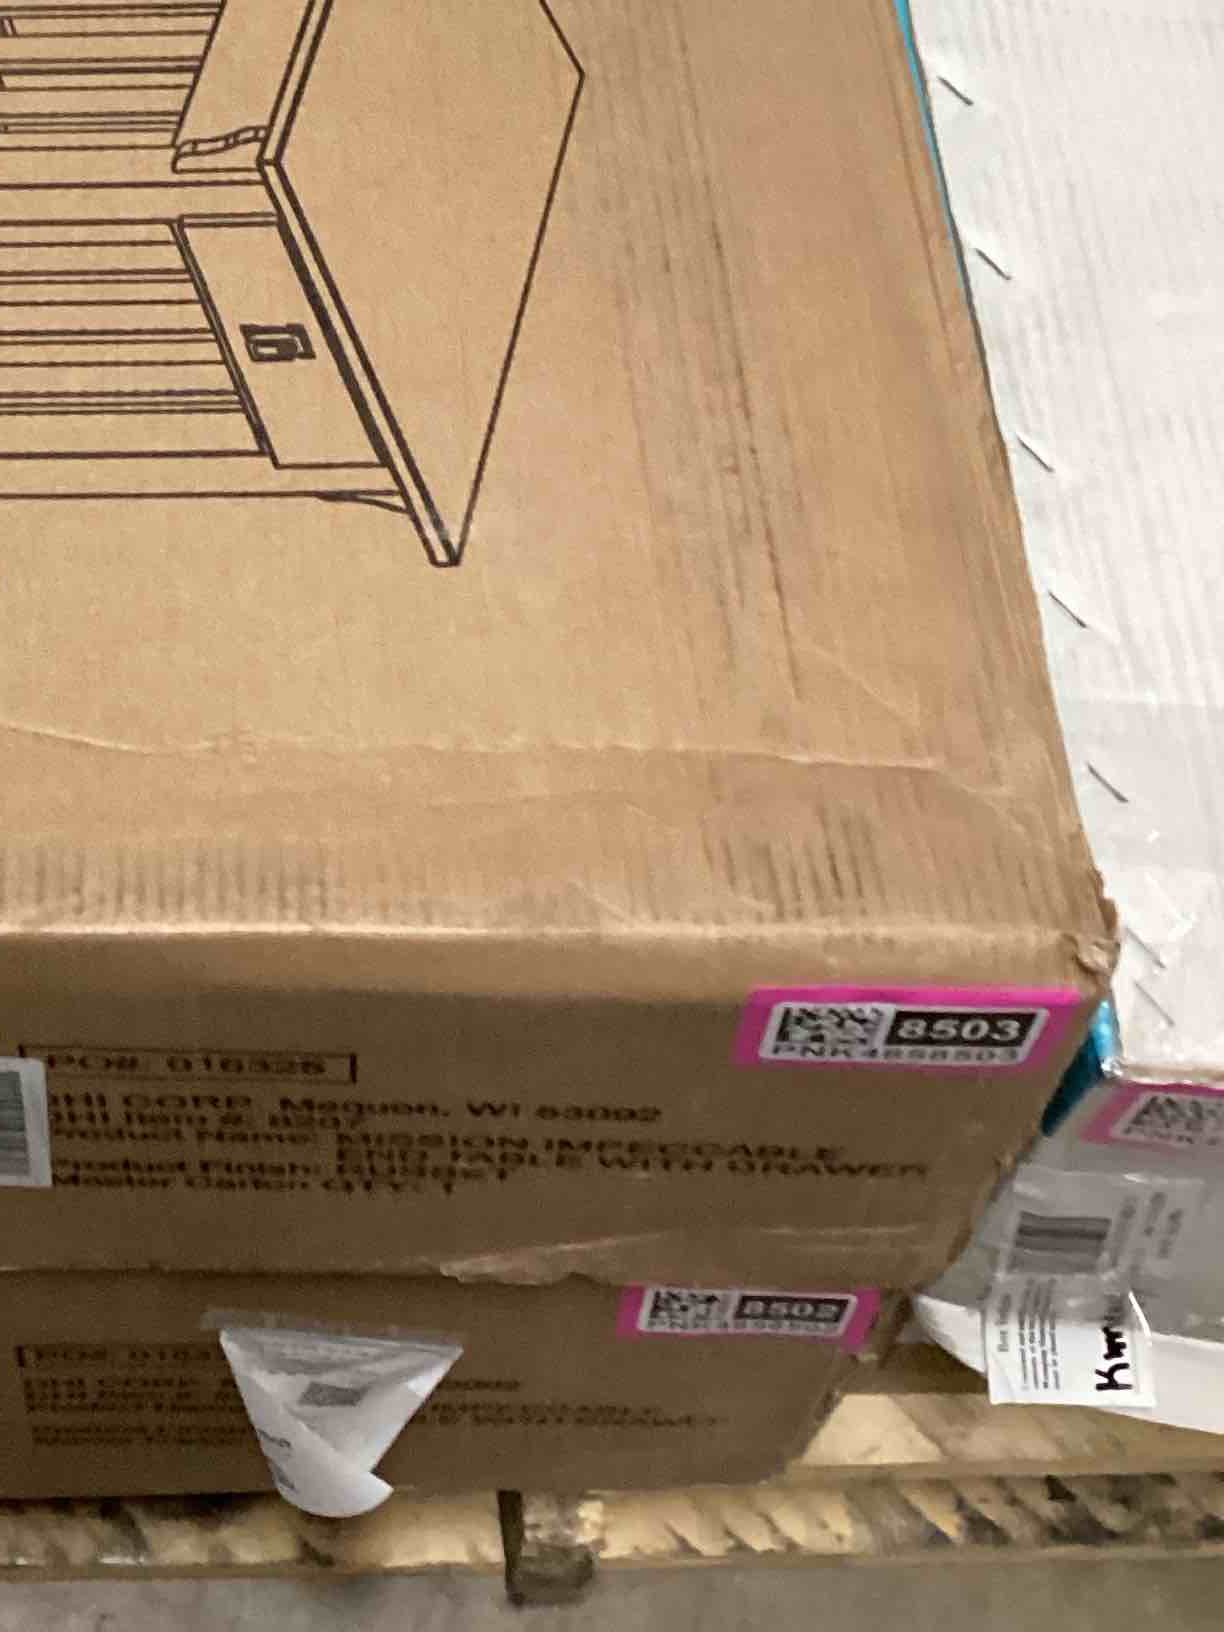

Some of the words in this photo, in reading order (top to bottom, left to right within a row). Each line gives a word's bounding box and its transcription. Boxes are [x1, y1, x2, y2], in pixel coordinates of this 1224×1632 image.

[896, 1017, 1023, 1043] 8503
[466, 1101, 522, 1117] WI
[544, 1137, 844, 1161] IMPECCABLE
[727, 1159, 929, 1179] DRAWER
